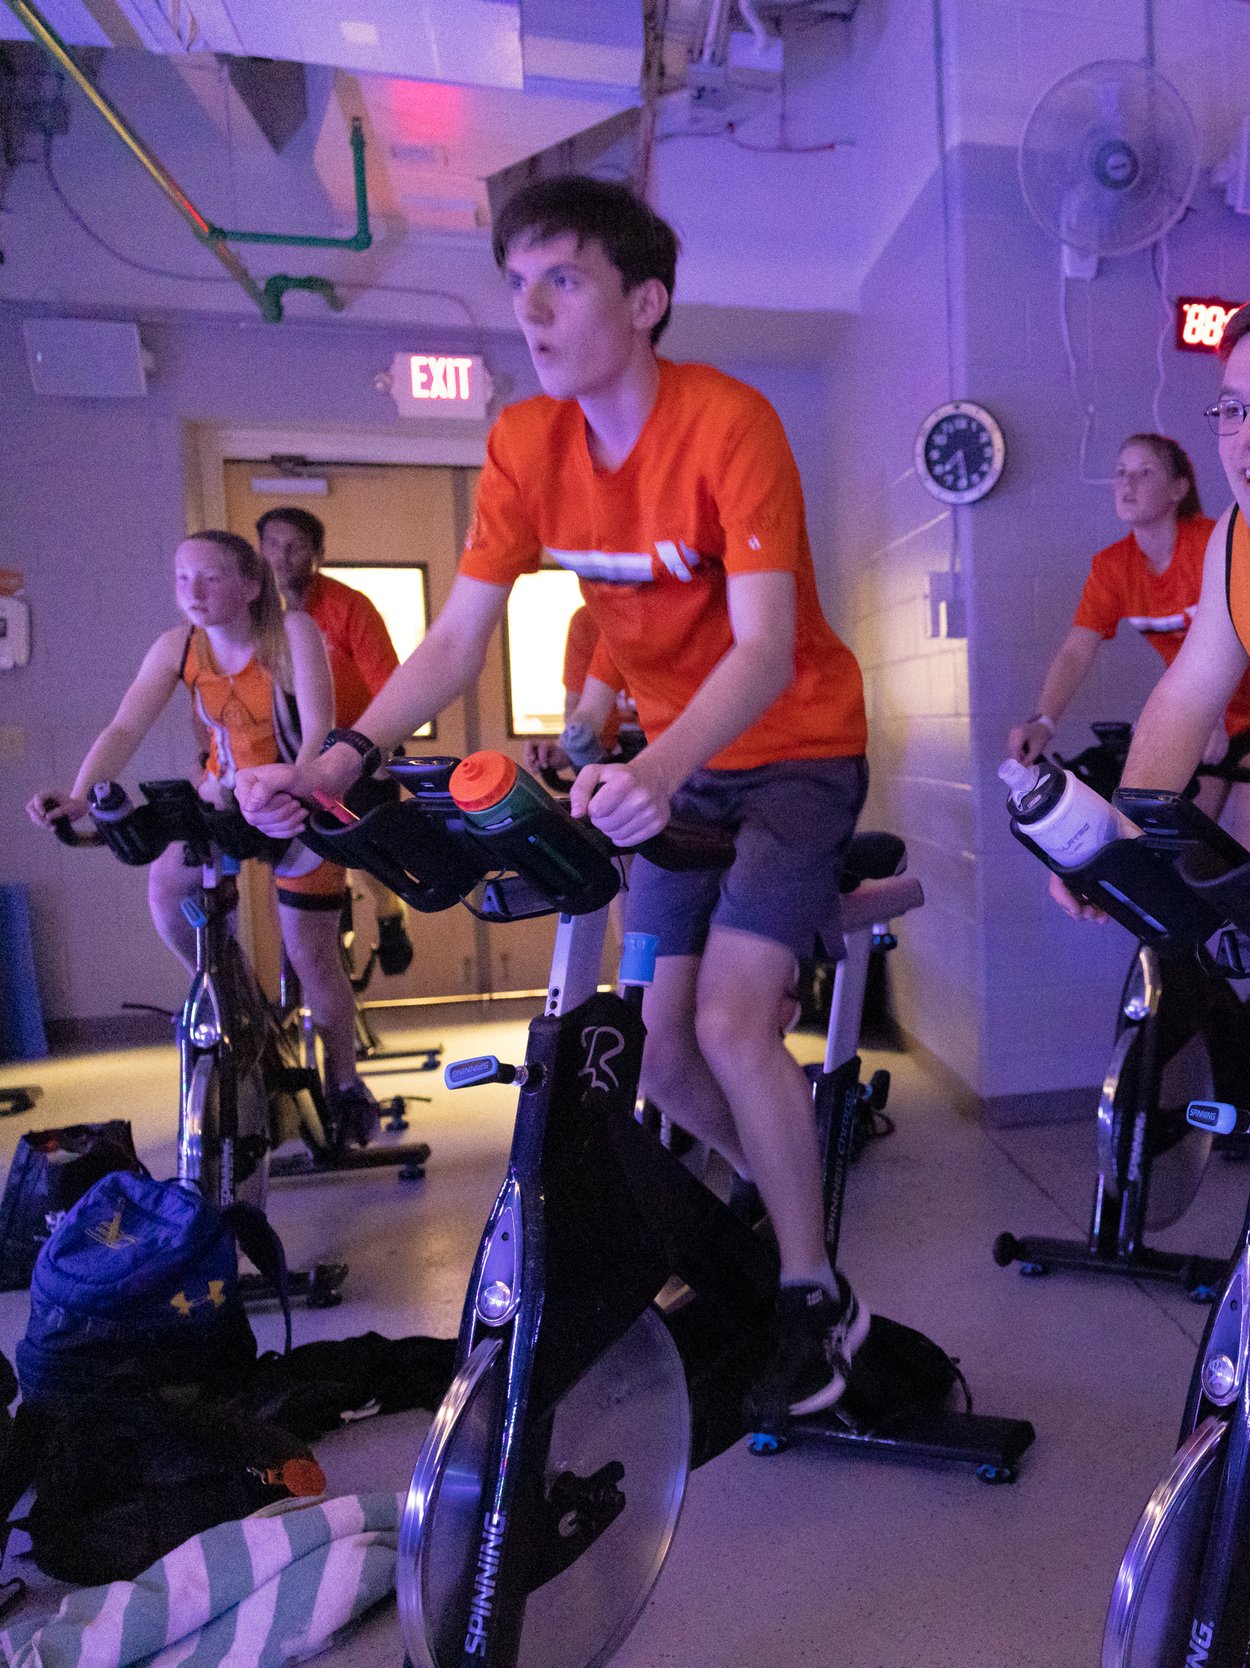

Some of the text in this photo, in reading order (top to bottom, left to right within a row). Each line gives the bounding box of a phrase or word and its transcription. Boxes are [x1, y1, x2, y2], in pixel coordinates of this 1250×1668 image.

[410, 355, 473, 400] EXIT
[451, 1061, 490, 1078] SPINNING
[1190, 1108, 1217, 1121] SPINNING
[464, 1511, 506, 1657] SPINNING
